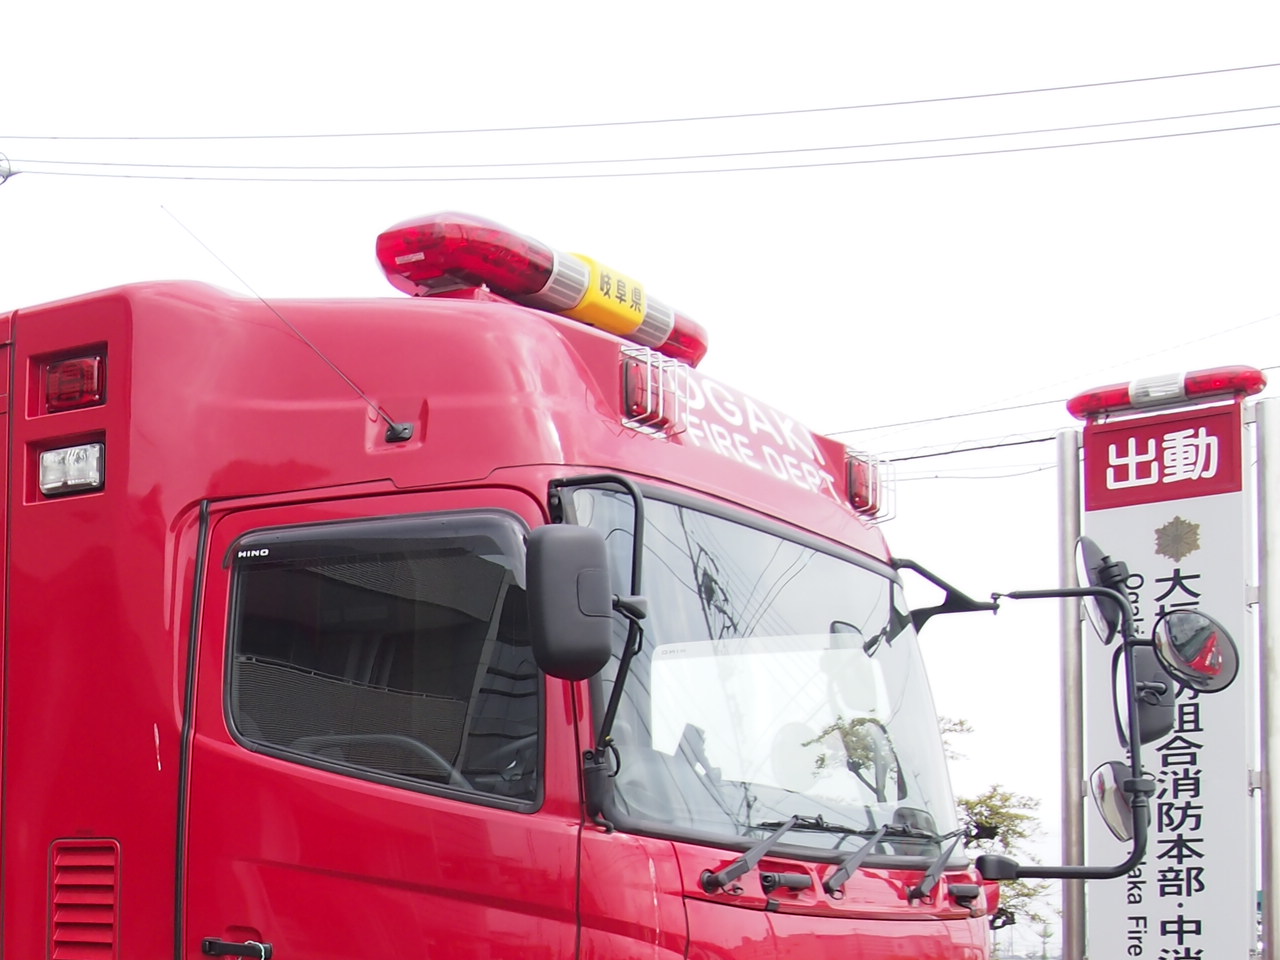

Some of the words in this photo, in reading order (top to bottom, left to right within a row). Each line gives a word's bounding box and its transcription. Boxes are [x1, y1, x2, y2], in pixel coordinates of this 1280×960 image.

[600, 270, 642, 313] 岐阜県
[666, 367, 826, 466] OGAKI
[681, 412, 763, 471] FIRE
[1106, 426, 1219, 490] 出動
[237, 548, 270, 559] HINO
[1127, 916, 1148, 957] Fire
